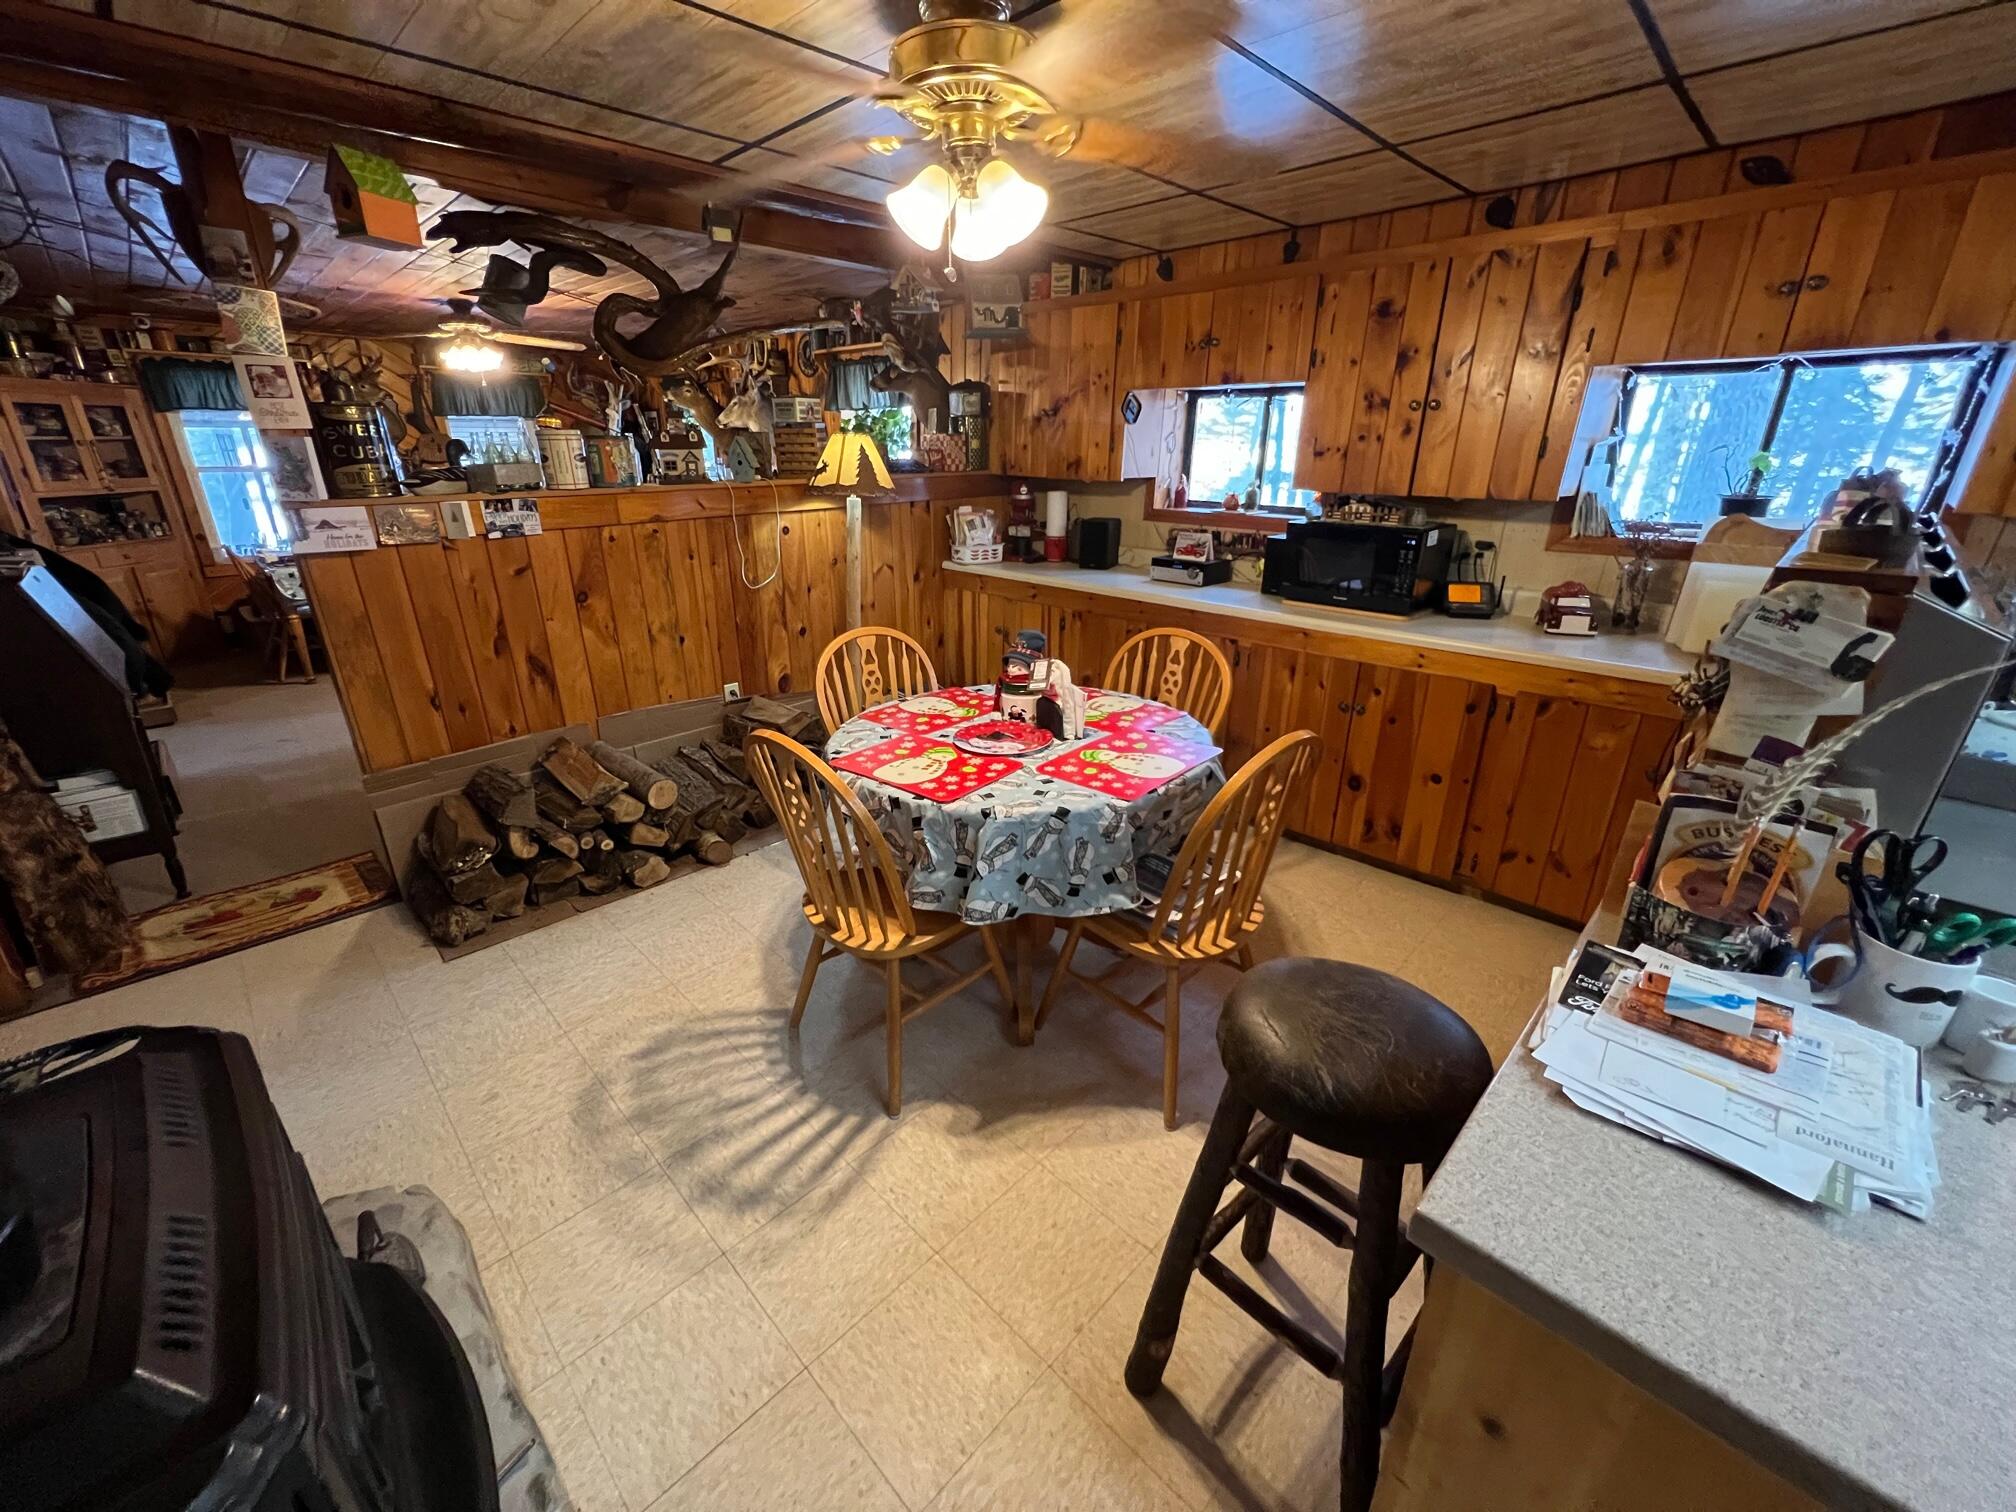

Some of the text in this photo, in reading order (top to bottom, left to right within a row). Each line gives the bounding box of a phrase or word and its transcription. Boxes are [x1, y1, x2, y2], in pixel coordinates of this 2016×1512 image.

[322, 423, 383, 440] SWEE
[1578, 974, 1603, 986] Ford
[1567, 995, 1602, 1013] Fo
[1795, 1125, 1896, 1171] Hannaford
